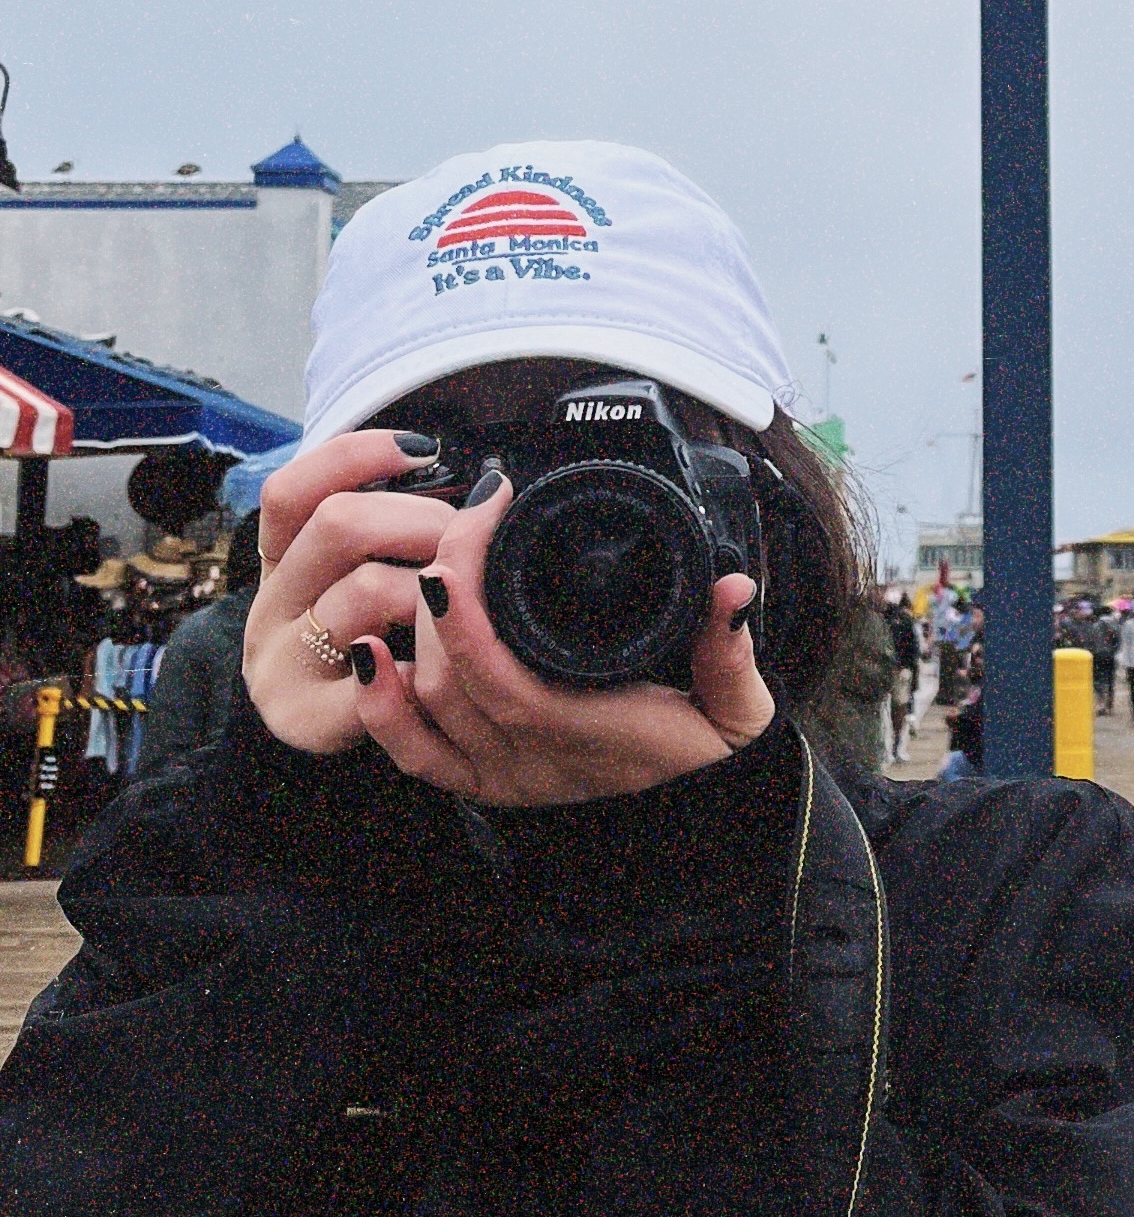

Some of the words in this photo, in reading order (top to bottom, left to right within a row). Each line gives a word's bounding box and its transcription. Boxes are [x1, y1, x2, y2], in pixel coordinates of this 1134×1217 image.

[408, 172, 496, 241] Spread
[499, 165, 613, 226] Kindness
[427, 239, 496, 268] Santa
[509, 235, 599, 253] Monica
[432, 265, 481, 296] It's
[485, 265, 505, 280] a
[509, 257, 591, 280] Vibe.
[565, 401, 642, 421] Nikon
